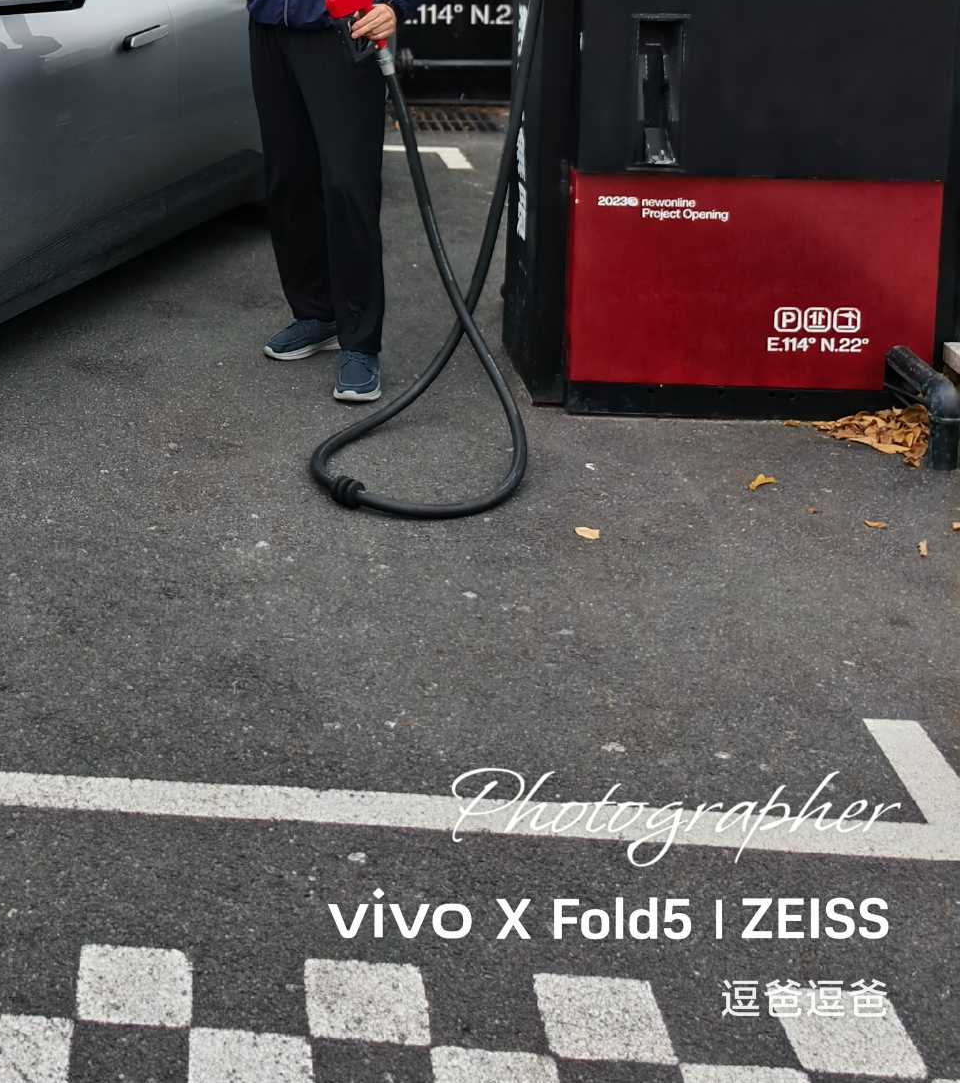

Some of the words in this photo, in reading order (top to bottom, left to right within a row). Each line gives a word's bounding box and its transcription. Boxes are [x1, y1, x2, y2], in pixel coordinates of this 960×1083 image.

[404, 3, 463, 25] .114°
[470, 4, 513, 25] N.2
[641, 197, 696, 208] newonline
[642, 208, 681, 220] Project
[683, 209, 729, 222] Opening
[767, 336, 816, 352] E.114°
[820, 337, 869, 353] N.22°
